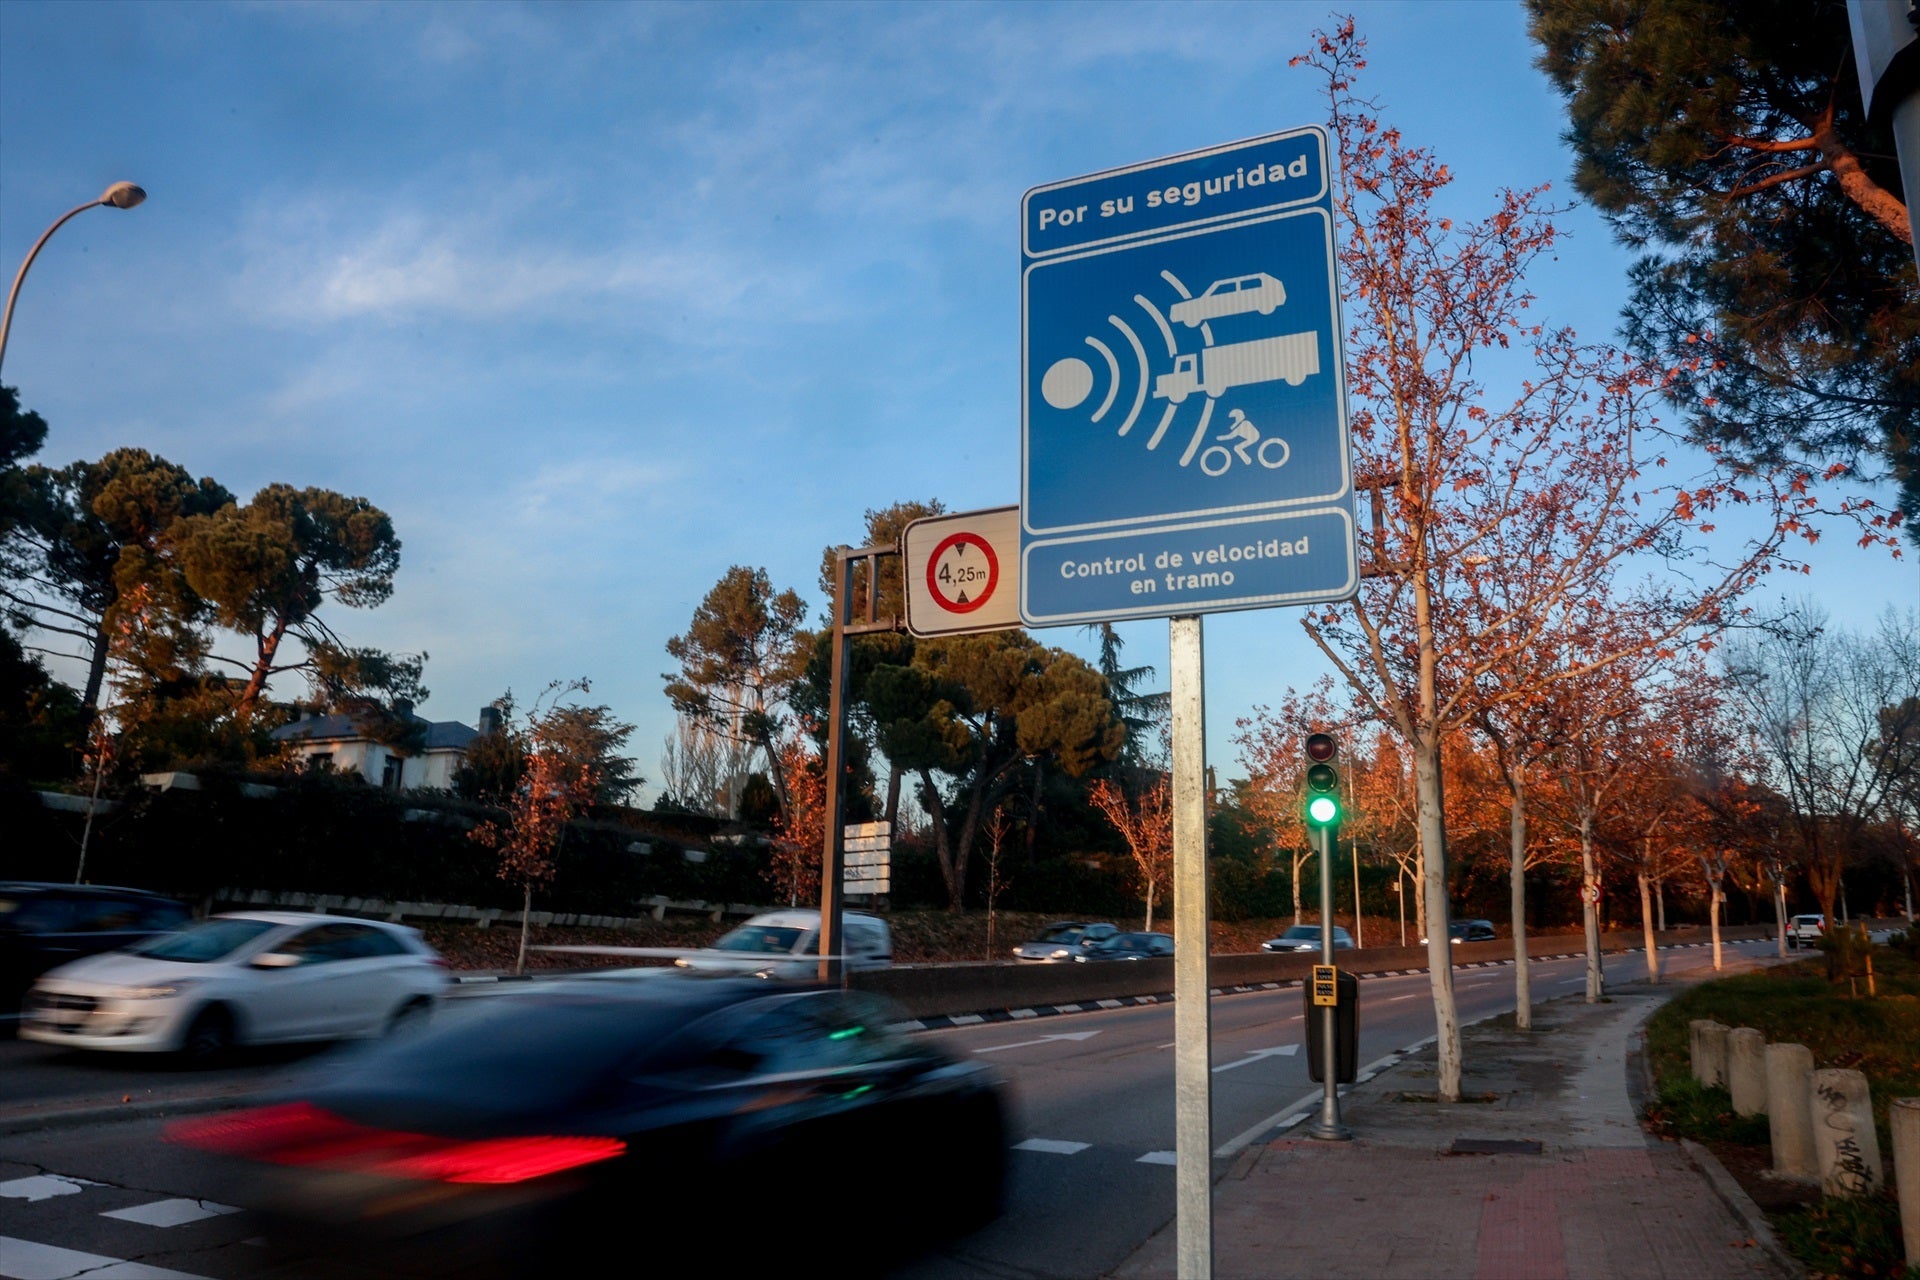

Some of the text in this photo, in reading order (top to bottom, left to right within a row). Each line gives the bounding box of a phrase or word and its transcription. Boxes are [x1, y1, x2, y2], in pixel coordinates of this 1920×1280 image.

[1039, 155, 1307, 230] Por su seguridad
[1060, 536, 1309, 578] Control de velocidad
[938, 562, 986, 587] 4,25m
[1131, 571, 1235, 594] en tramo
